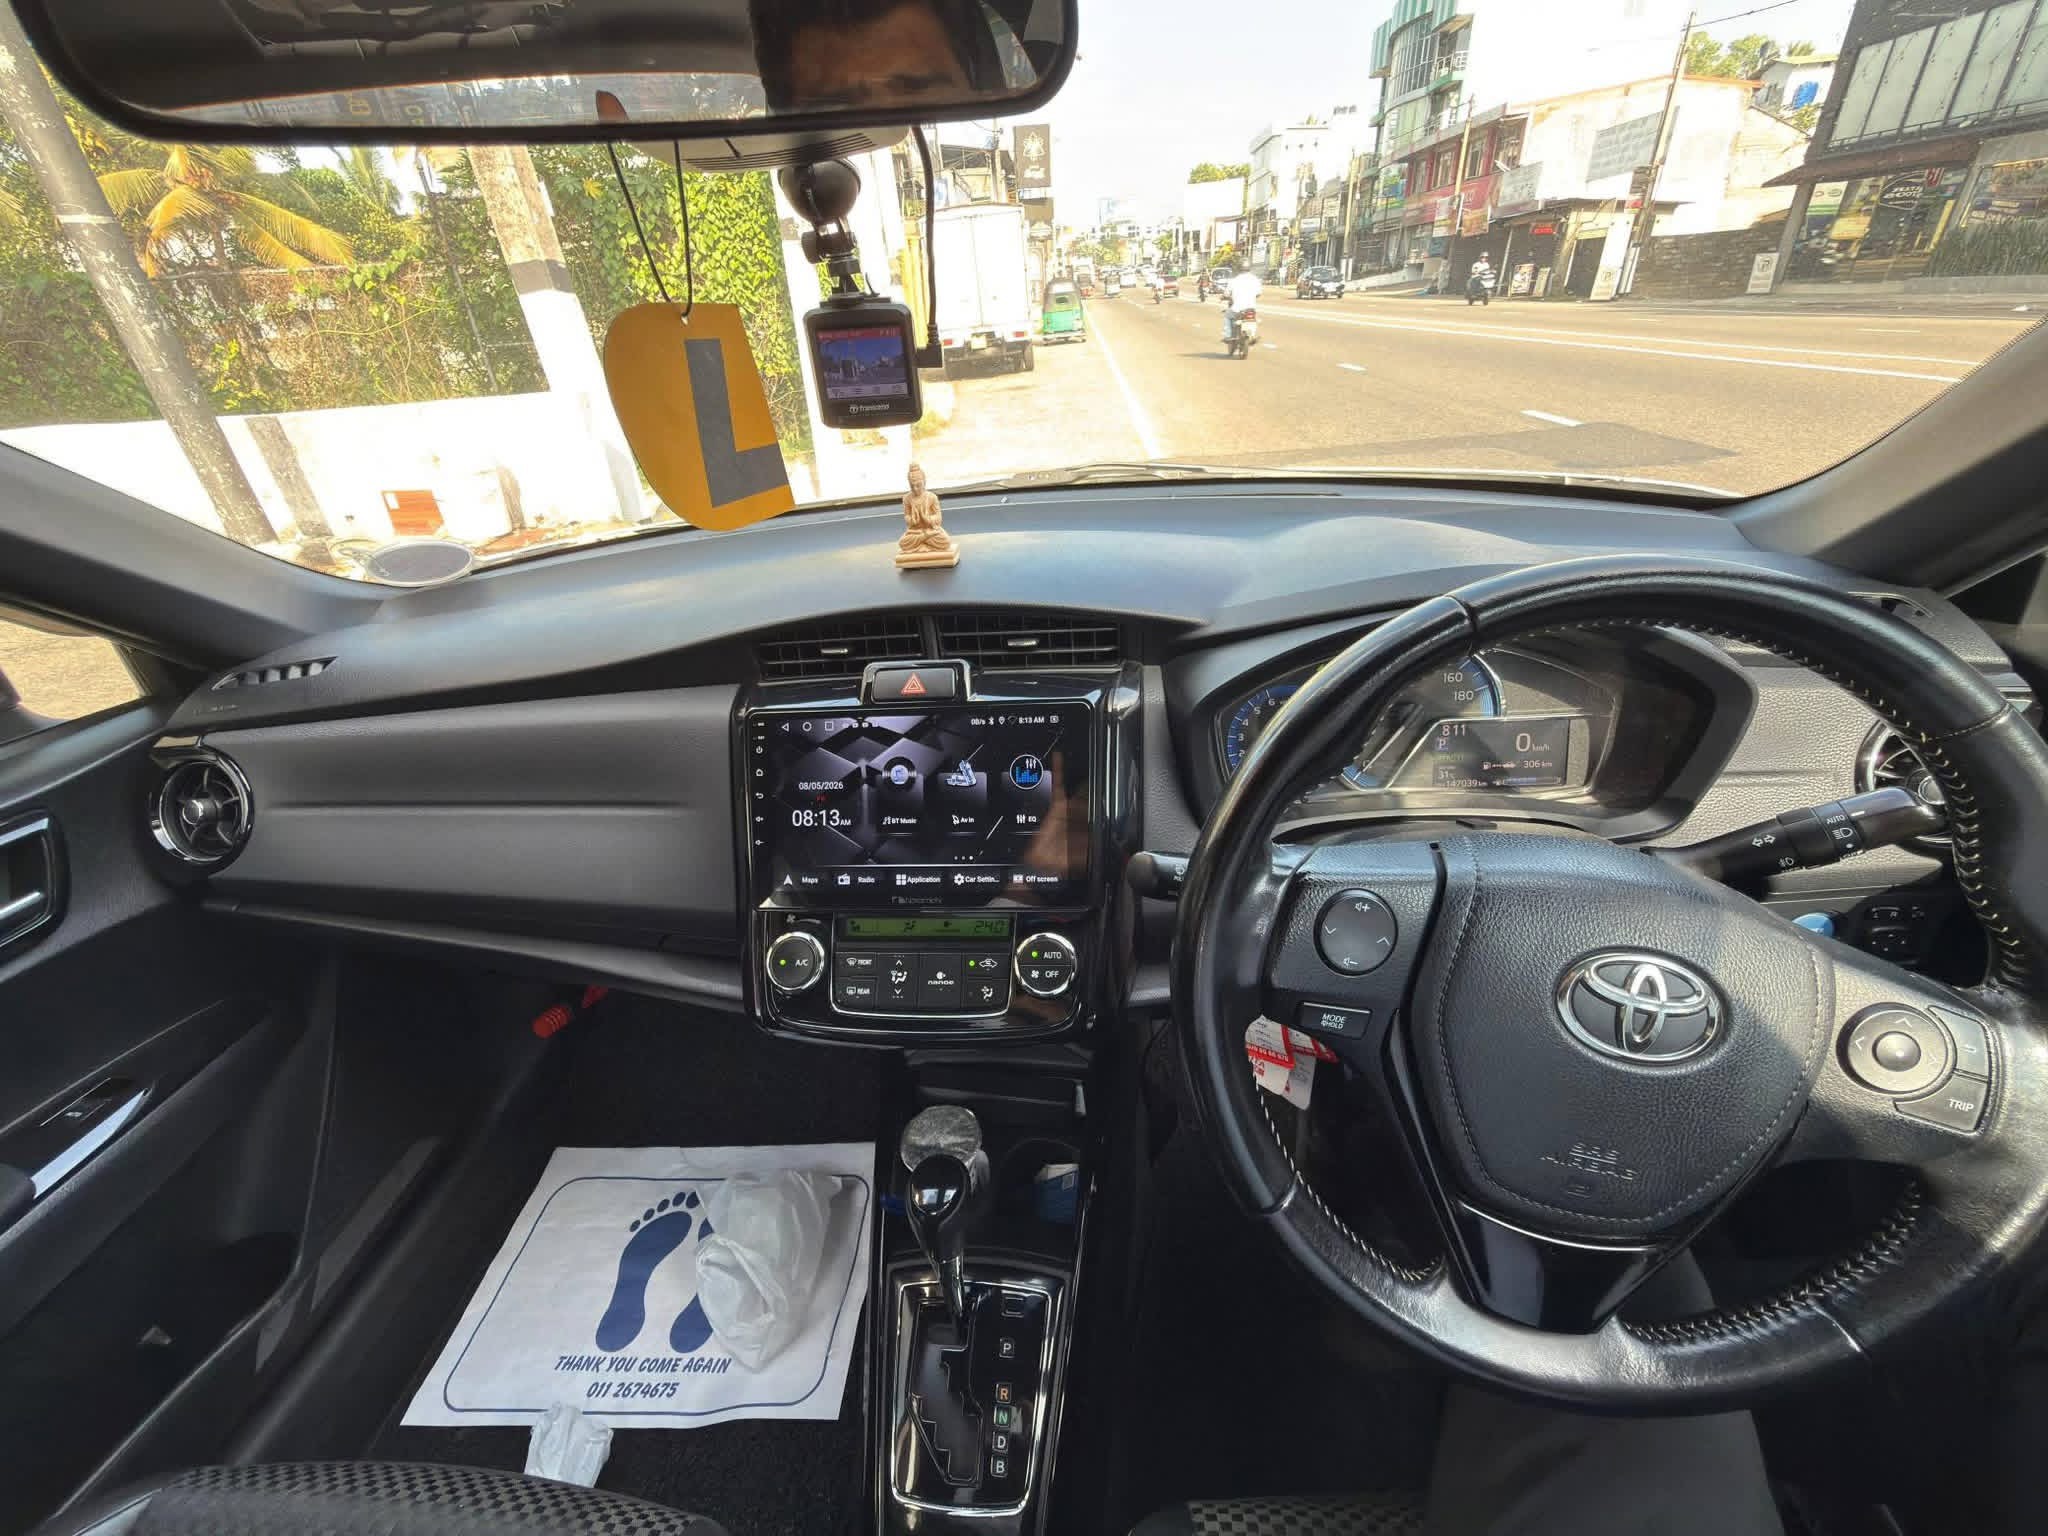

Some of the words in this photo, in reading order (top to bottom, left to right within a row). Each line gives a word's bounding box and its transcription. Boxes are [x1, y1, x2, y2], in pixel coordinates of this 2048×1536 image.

[684, 339, 789, 508] L
[1443, 671, 1463, 683] 160
[1454, 690, 1474, 701] 180
[1254, 706, 1261, 715] 5
[1018, 716, 1033, 724] 8:13
[1033, 716, 1045, 724] AM
[1242, 718, 1249, 726] 4
[1238, 733, 1245, 741] 3
[1439, 739, 1447, 749] P
[1516, 733, 1531, 752] 0
[1523, 760, 1540, 769] 306
[798, 781, 844, 791] 08/05/2026
[792, 809, 840, 827] 08:13
[1826, 814, 1846, 825] AUTO
[801, 876, 819, 884] Maps
[907, 875, 941, 884] Application
[965, 875, 976, 883] Car
[1043, 951, 1062, 959] AUTO
[795, 959, 809, 967] A/C
[1045, 970, 1060, 978] OFF
[1321, 1013, 1346, 1024] MODE
[1327, 1021, 1344, 1029] HOLD
[1949, 1098, 1975, 1112] TRIP
[1002, 1342, 1012, 1354] P
[554, 1355, 608, 1373] THANK
[605, 1356, 639, 1373] YOU
[638, 1356, 683, 1373] COME
[682, 1356, 733, 1374] AGAIN
[586, 1381, 613, 1398] 011
[612, 1381, 680, 1399] 2674675
[999, 1387, 1009, 1401] R
[999, 1411, 1009, 1421] N
[997, 1435, 1006, 1449] D
[995, 1460, 1005, 1474] B
